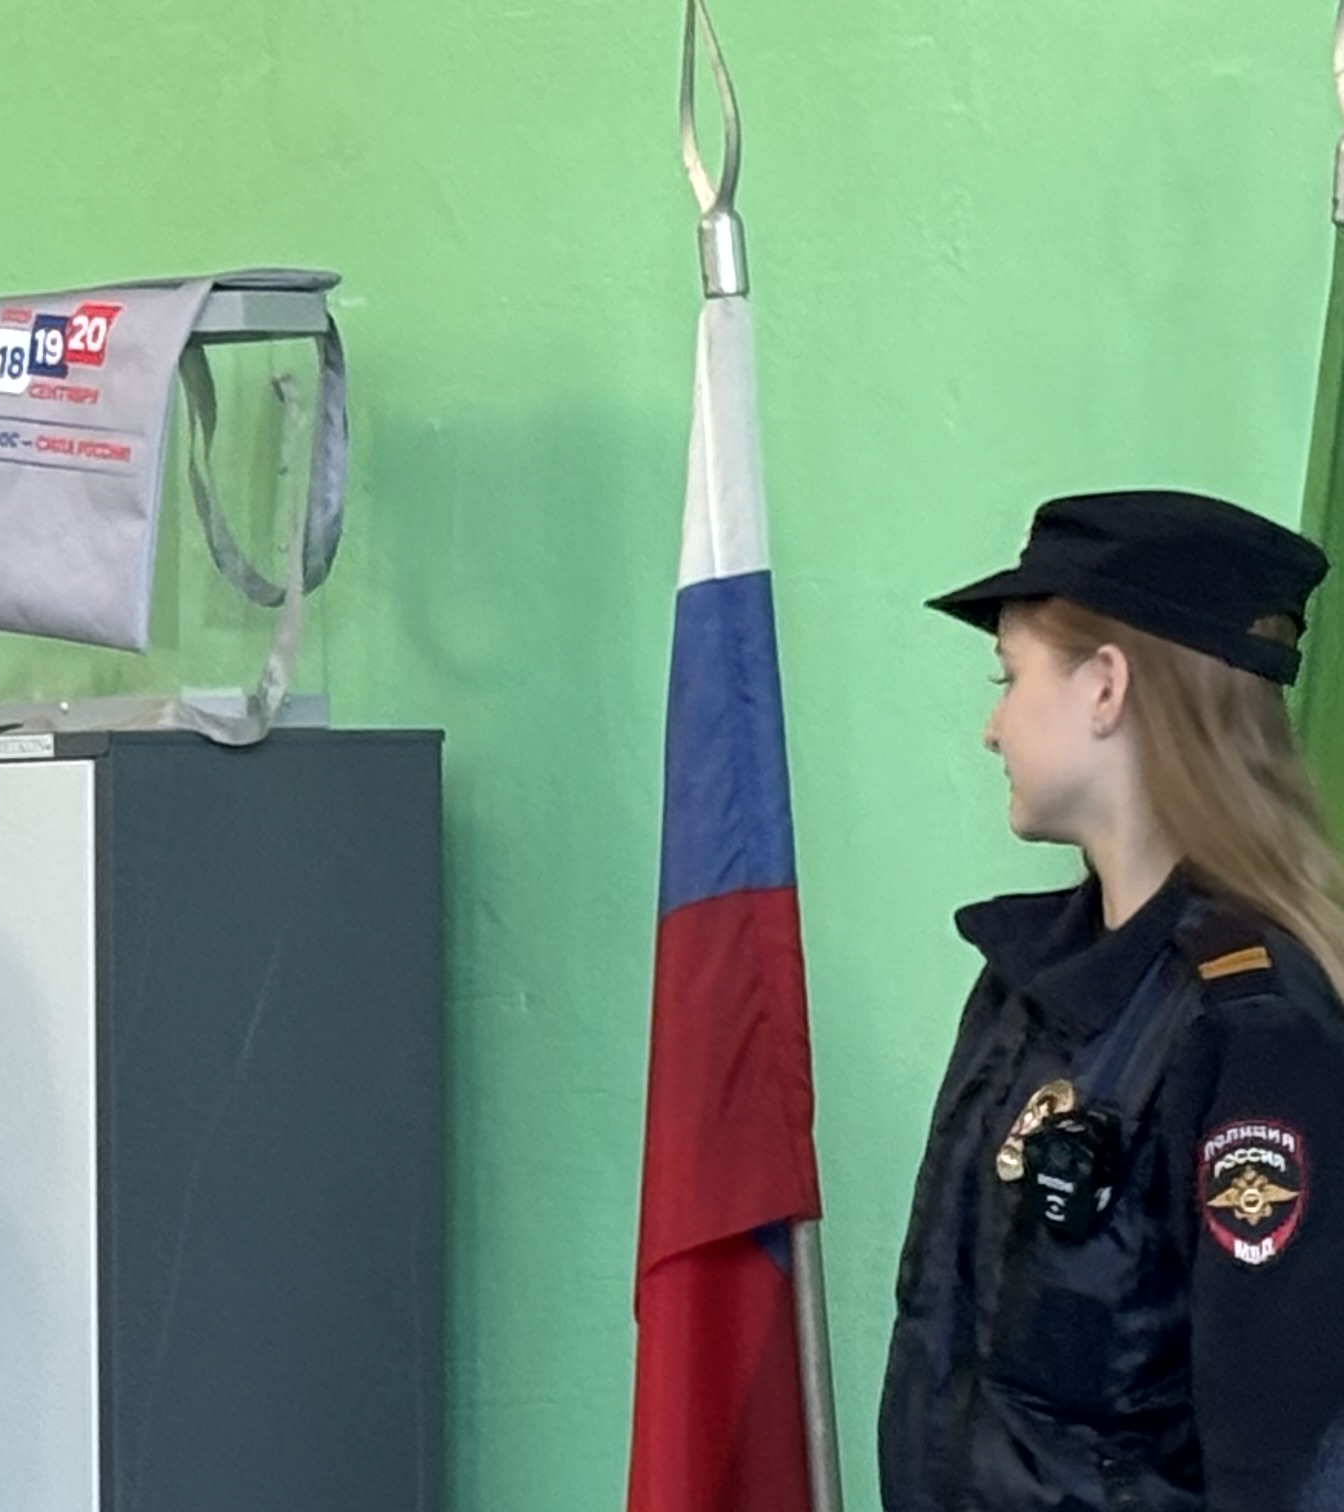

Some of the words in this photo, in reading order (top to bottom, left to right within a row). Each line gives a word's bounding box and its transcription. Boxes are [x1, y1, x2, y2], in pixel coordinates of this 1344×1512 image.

[34, 328, 64, 365] 19
[67, 315, 107, 352] 20
[1204, 1125, 1295, 1162] ПОЛИЦИЯ
[1214, 1147, 1286, 1179] РОССИЯ
[1234, 1237, 1276, 1265] МВД
